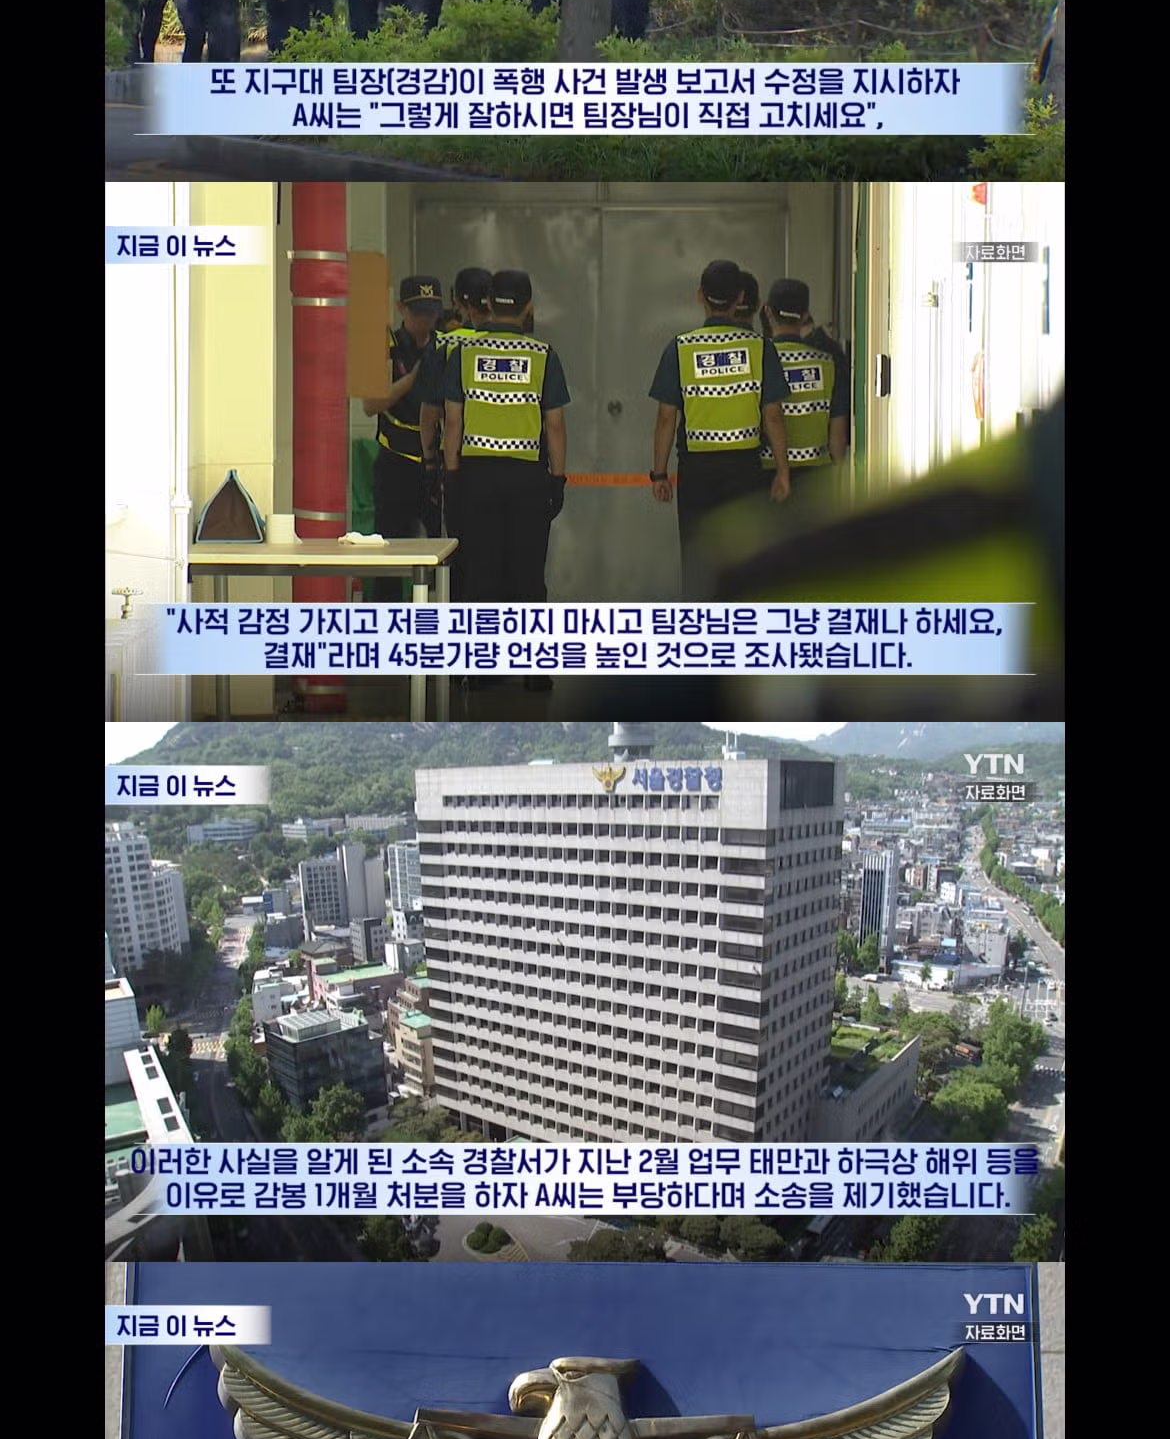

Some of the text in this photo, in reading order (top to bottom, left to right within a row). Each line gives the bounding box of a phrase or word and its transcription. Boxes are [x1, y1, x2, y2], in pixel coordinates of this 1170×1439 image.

[700, 365, 745, 376] POLICE
[480, 372, 523, 381] POLICE
[792, 382, 818, 390] LICE
